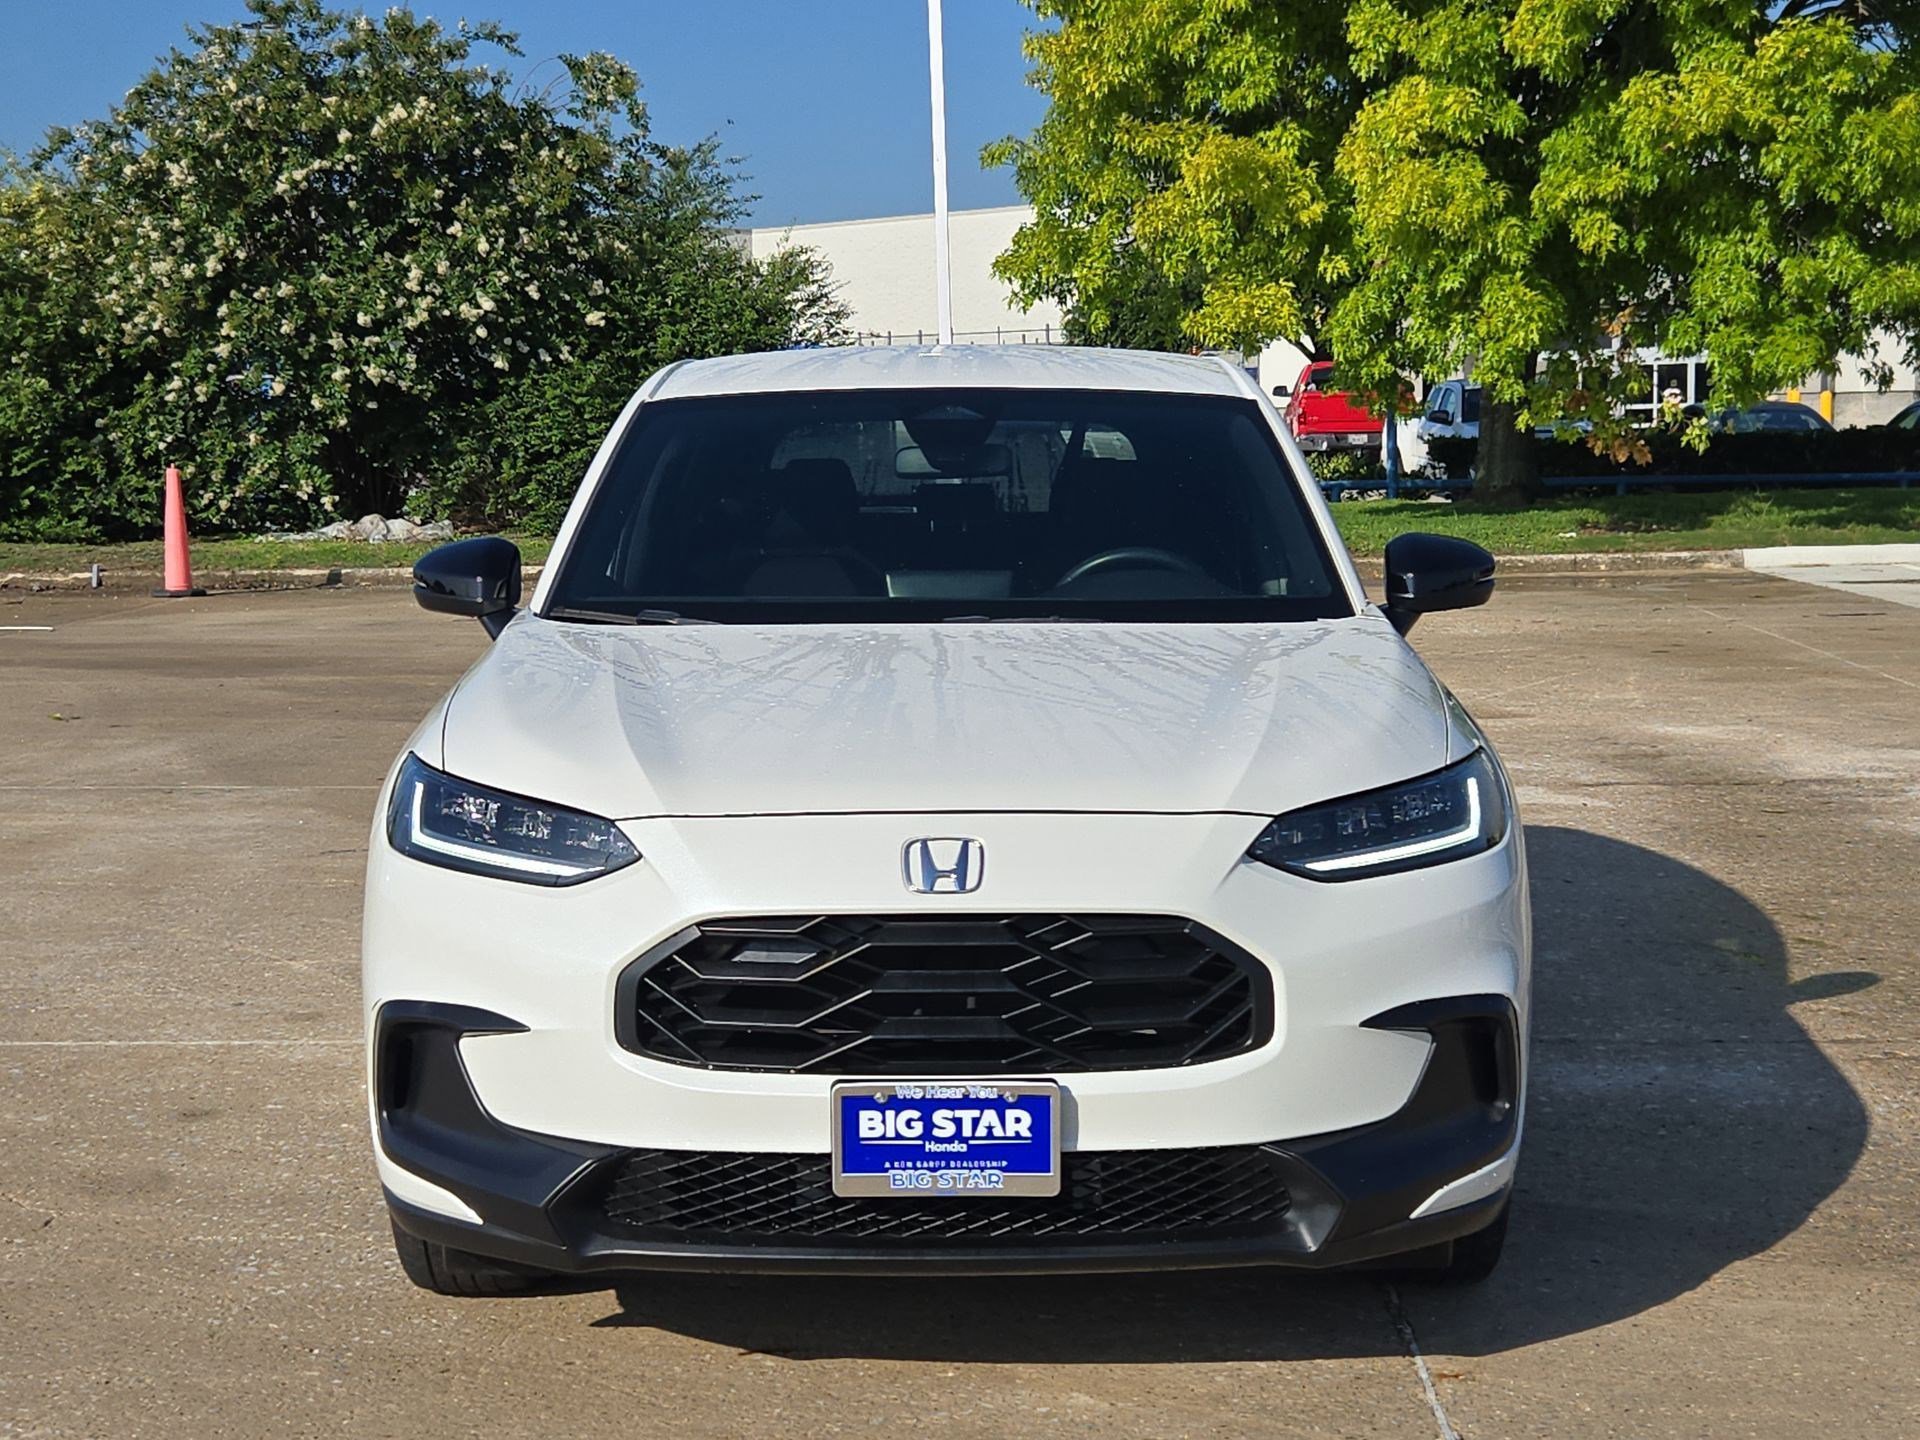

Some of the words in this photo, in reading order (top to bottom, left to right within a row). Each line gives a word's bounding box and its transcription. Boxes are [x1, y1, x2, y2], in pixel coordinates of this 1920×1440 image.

[895, 1086, 923, 1099] We
[925, 1086, 965, 1099] Hear
[967, 1086, 998, 1099] You
[858, 1109, 924, 1138] BIG
[931, 1109, 1033, 1138] STAR
[925, 1141, 968, 1152] Honda
[889, 1170, 932, 1188] BIG
[937, 1170, 1004, 1188] STAR
